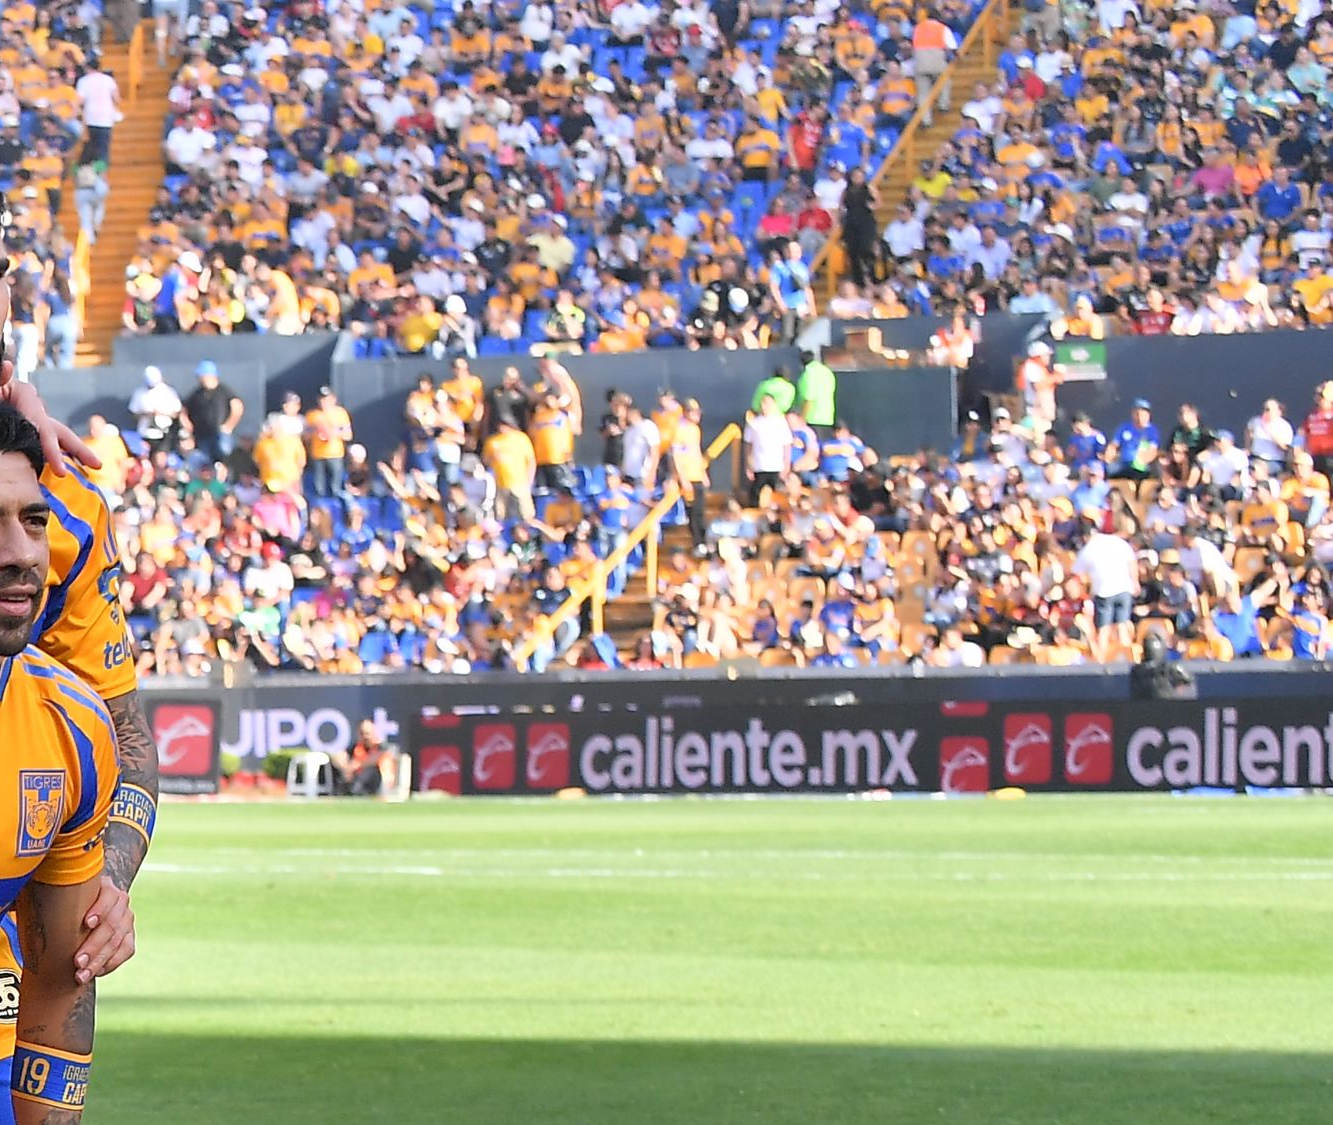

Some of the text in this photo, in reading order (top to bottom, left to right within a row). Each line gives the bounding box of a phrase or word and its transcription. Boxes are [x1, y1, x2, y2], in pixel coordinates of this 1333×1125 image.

[580, 714, 918, 789] caliente.mx
[25, 775, 62, 790] TIGRES
[19, 1056, 51, 1095] 19
